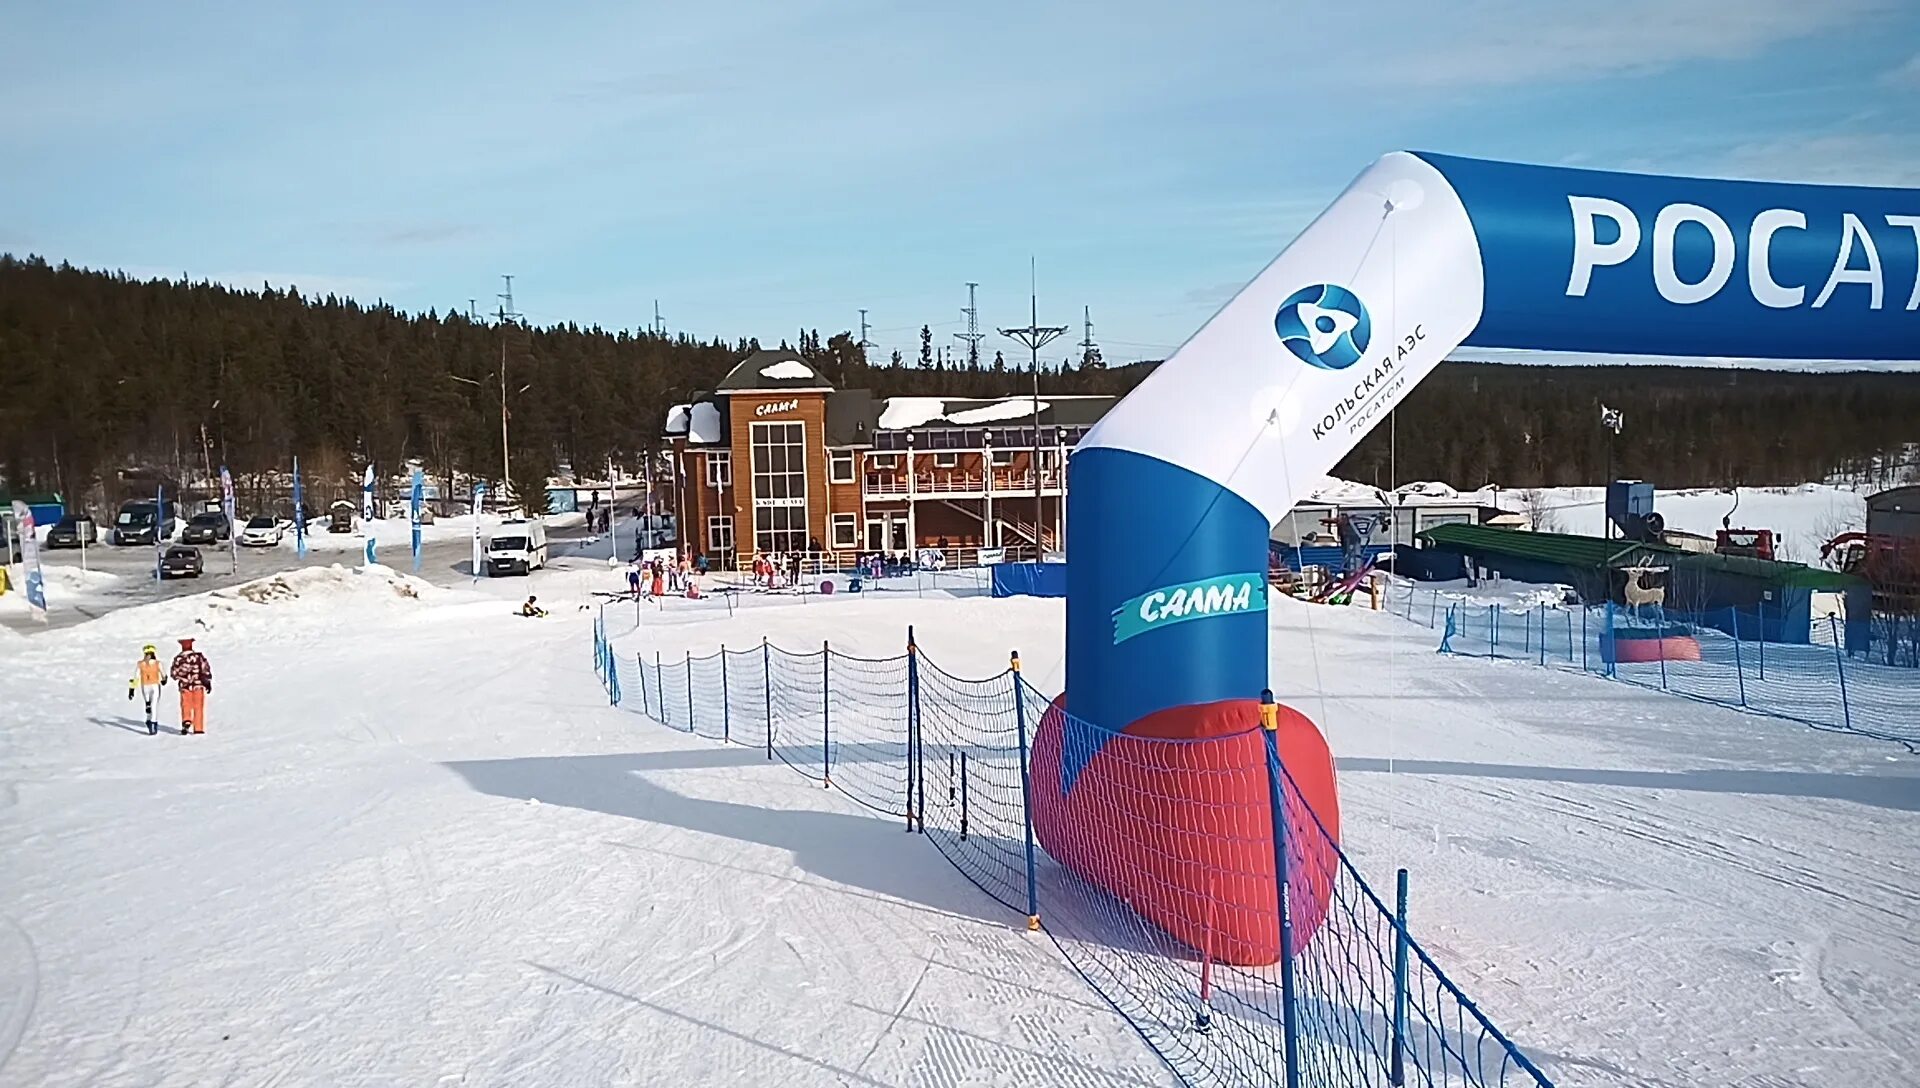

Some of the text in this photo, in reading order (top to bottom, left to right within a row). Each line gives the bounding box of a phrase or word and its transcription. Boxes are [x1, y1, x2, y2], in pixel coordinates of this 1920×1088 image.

[755, 398, 799, 417] САЛМА
[1312, 324, 1426, 441] КОЛЬСКАЯ АЭС
[1349, 376, 1406, 435] РОСАТОМ
[1139, 581, 1252, 623] САЛМА
